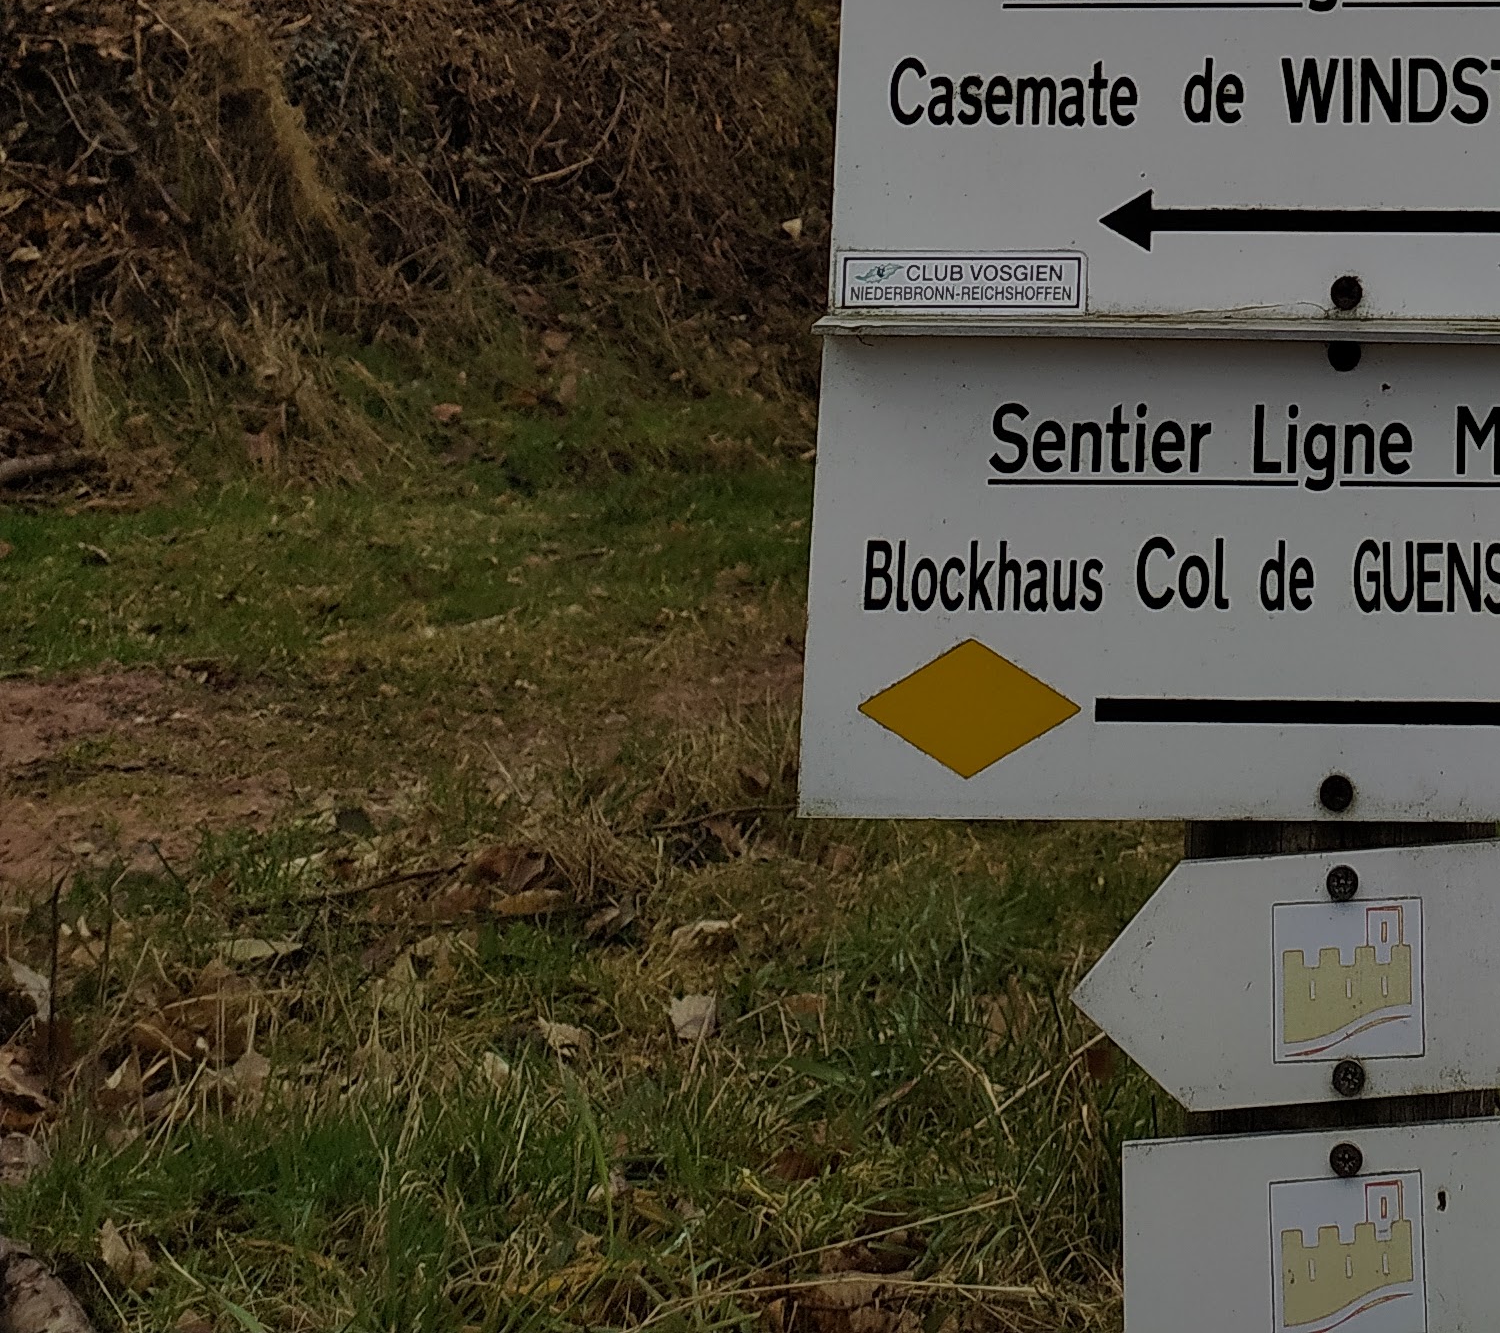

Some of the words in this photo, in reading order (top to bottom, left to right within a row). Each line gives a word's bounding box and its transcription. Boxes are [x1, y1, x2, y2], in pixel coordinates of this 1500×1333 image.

[889, 57, 1138, 128] Casemate
[1184, 58, 1244, 125] de
[850, 285, 1073, 302] NIEDERBRONN-REICHSHOFFEN
[905, 264, 965, 283] CLUB
[969, 264, 1064, 283] VOSGIEN
[989, 403, 1212, 475] Sentier
[1253, 405, 1413, 492] Ligne
[863, 540, 1103, 612] Blockhaus
[1136, 536, 1229, 612] Col
[1259, 540, 1315, 612] de
